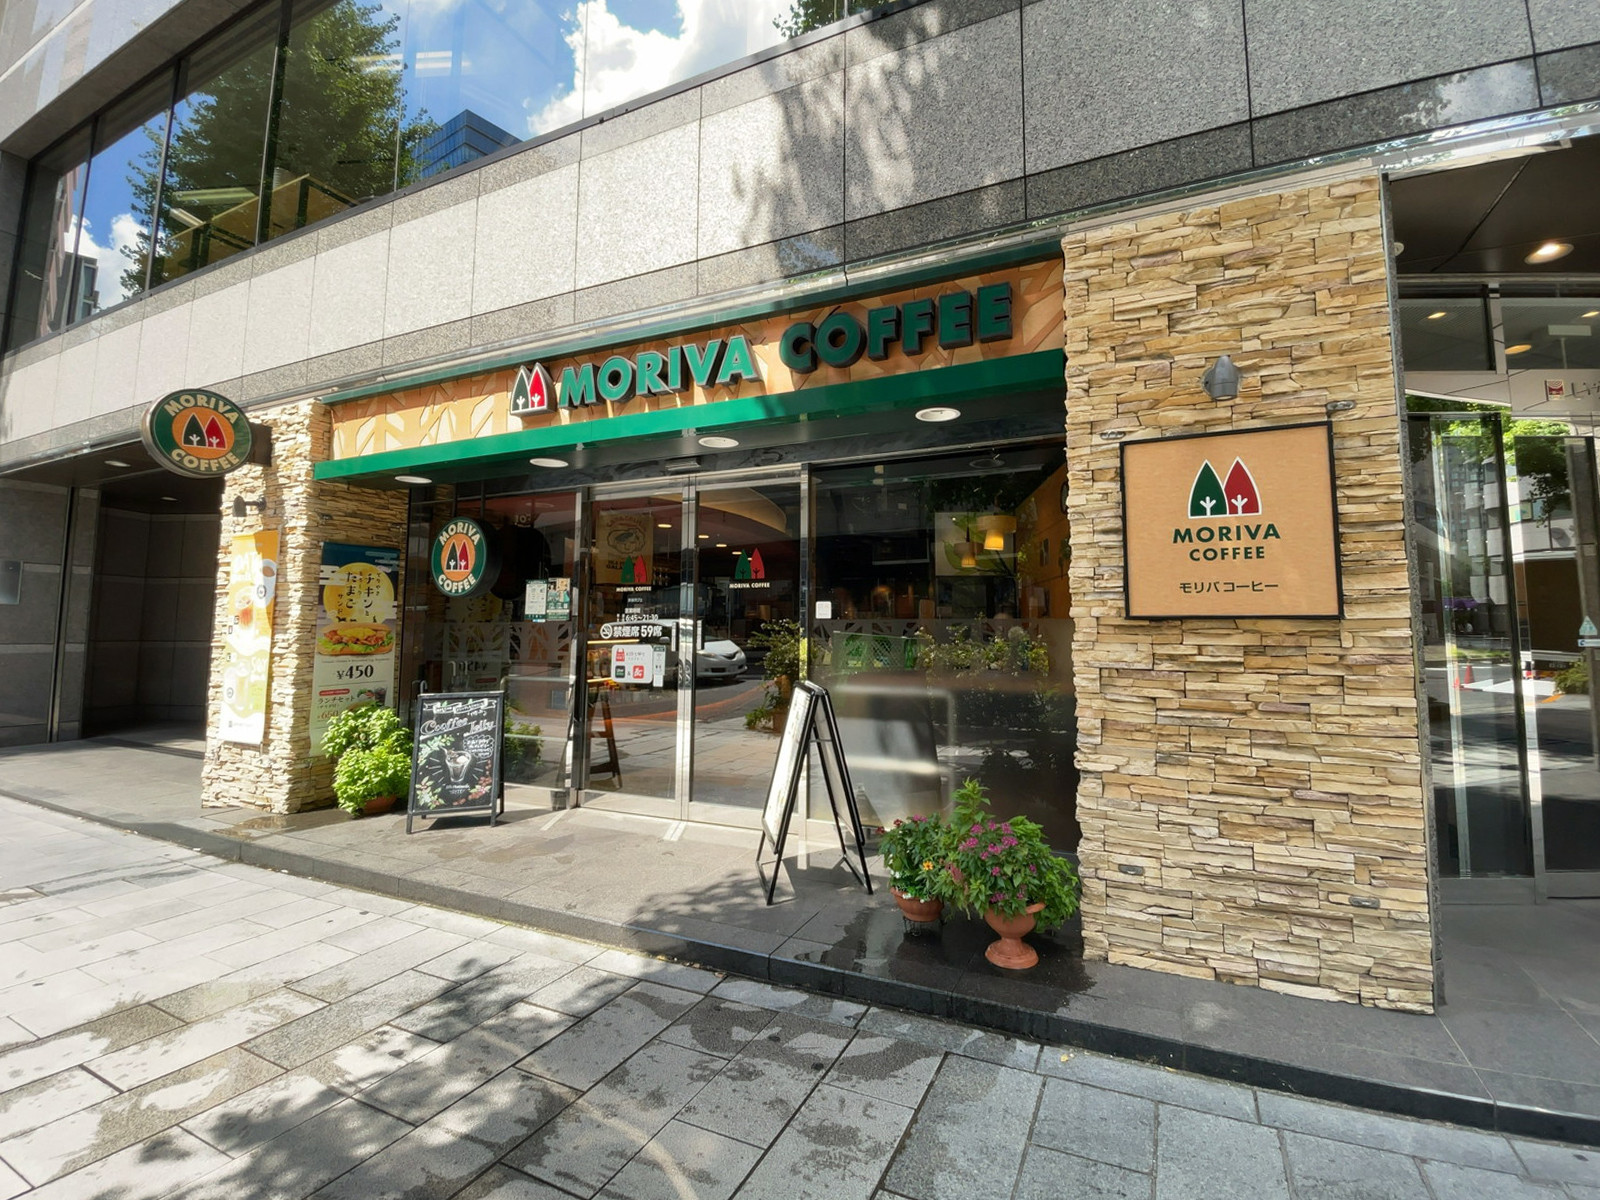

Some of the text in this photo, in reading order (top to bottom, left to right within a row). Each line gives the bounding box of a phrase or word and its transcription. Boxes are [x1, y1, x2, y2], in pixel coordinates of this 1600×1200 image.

[558, 282, 1014, 410] MORIVA COFFEE
[164, 394, 240, 424] MORIVA
[171, 448, 240, 471] COFFEE
[439, 522, 481, 546] MORIVA
[1172, 523, 1281, 544] MORIVA
[1189, 546, 1265, 562] COFFEE
[346, 572, 357, 609] たまご
[438, 573, 477, 593] COFFEE
[1179, 580, 1279, 594] モリバコーヒー
[336, 664, 374, 680] ¥450
